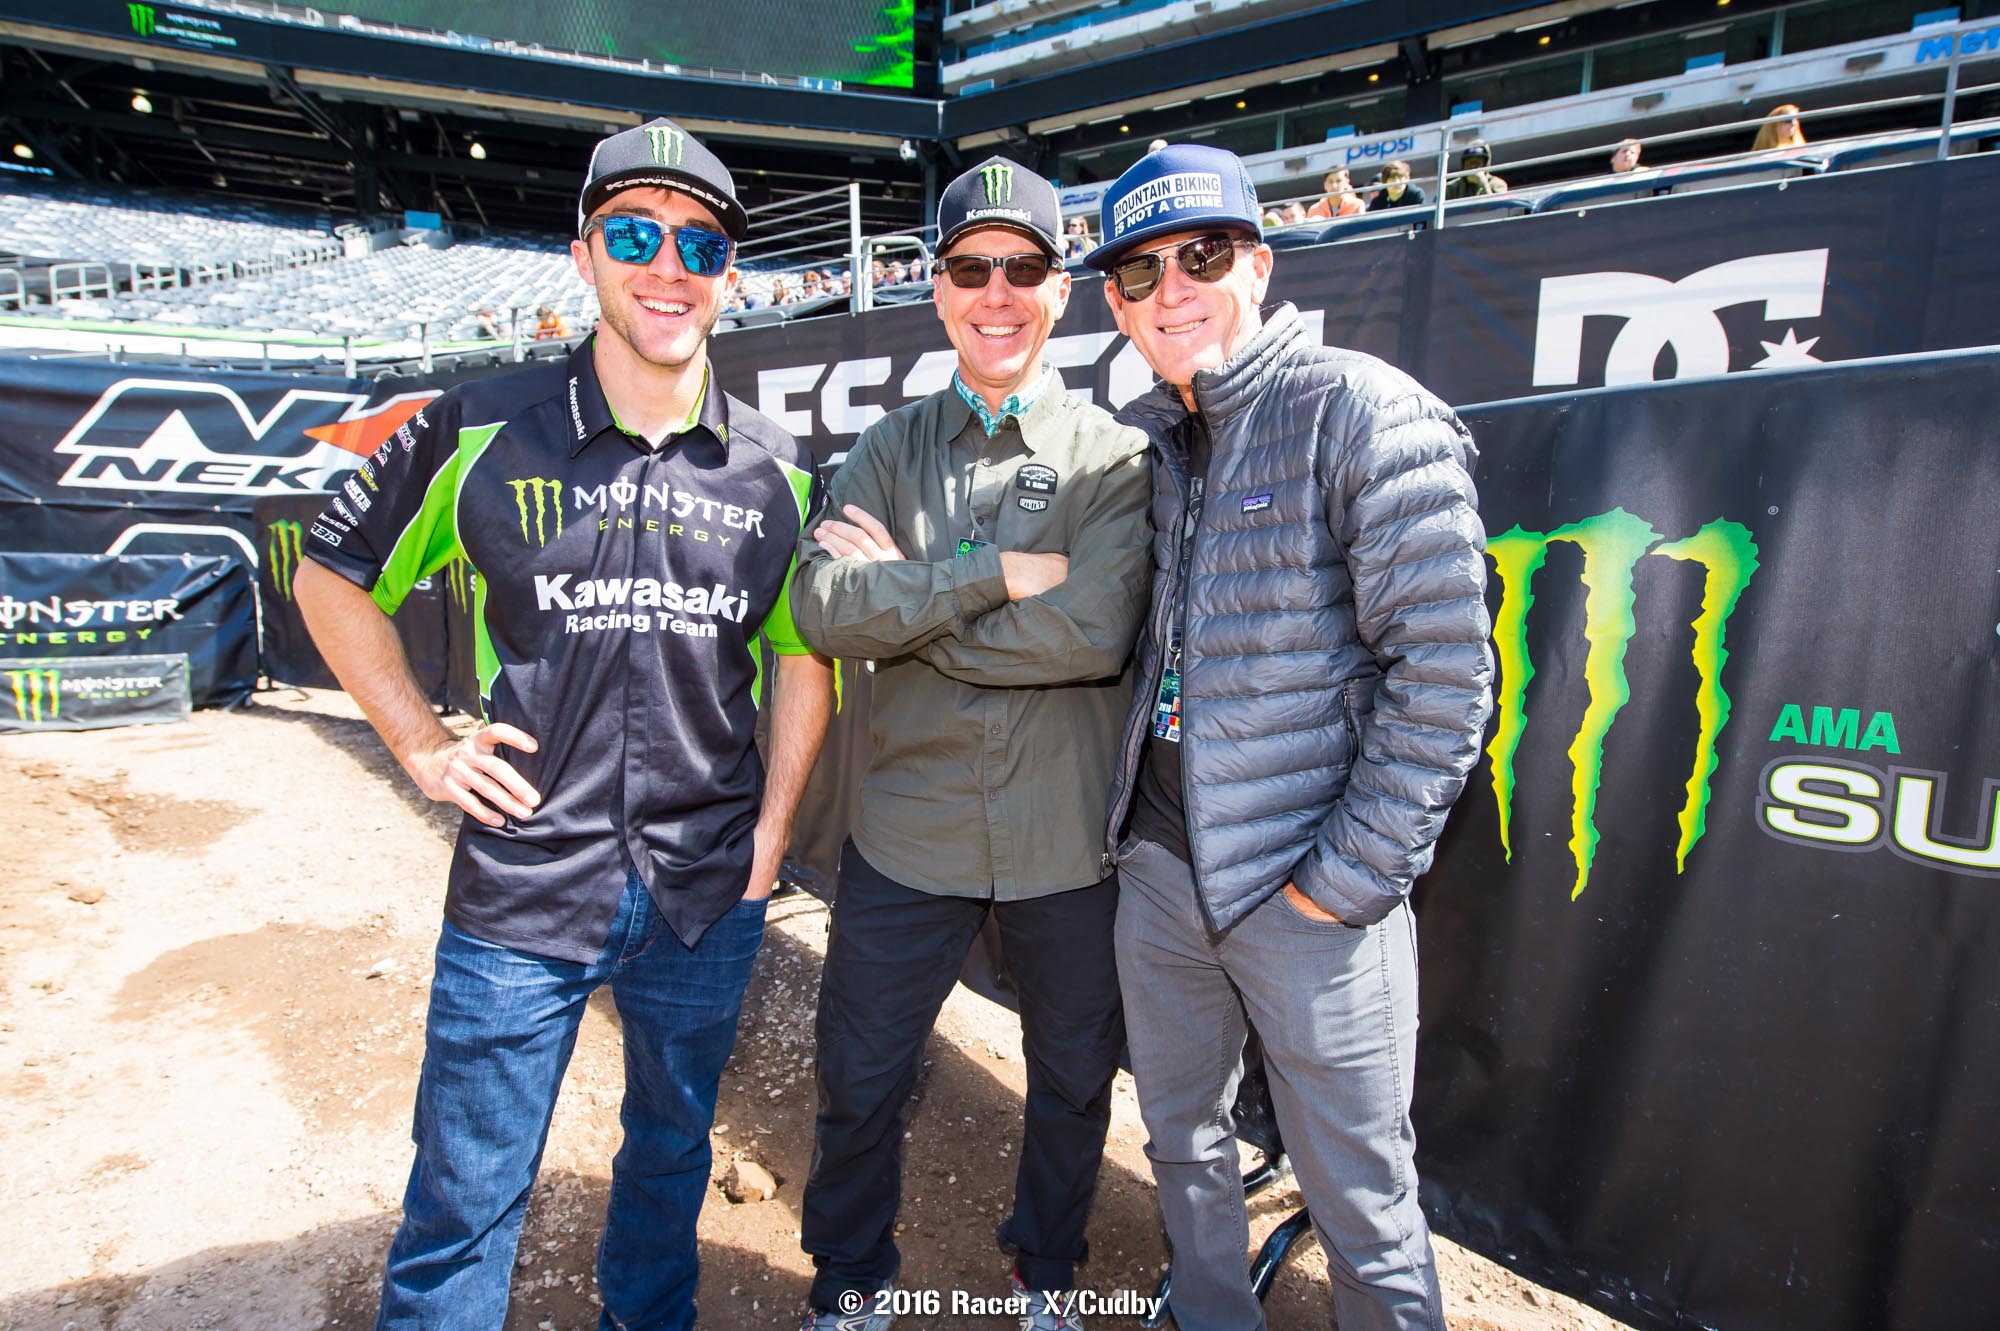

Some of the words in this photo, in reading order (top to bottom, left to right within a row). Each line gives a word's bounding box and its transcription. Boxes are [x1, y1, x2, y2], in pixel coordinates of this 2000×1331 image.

[605, 176, 729, 210] Kawasaki
[1114, 178, 1171, 219] MOUNTAIN
[1174, 176, 1220, 193] BIKING
[966, 208, 1032, 222] Kawasaki
[1115, 220, 1126, 238] IS
[1127, 206, 1156, 227] NOT
[1158, 199, 1172, 214] A
[1175, 195, 1223, 210] CRIME
[568, 376, 587, 441] Kawasaki
[572, 475, 766, 539] MONSTER
[599, 518, 731, 548] ENERGY
[533, 573, 749, 624] Kawasaki
[564, 611, 651, 634] Racing
[656, 612, 718, 638] Team
[61, 675, 164, 693] MONSTER
[1768, 703, 1901, 755] AMA
